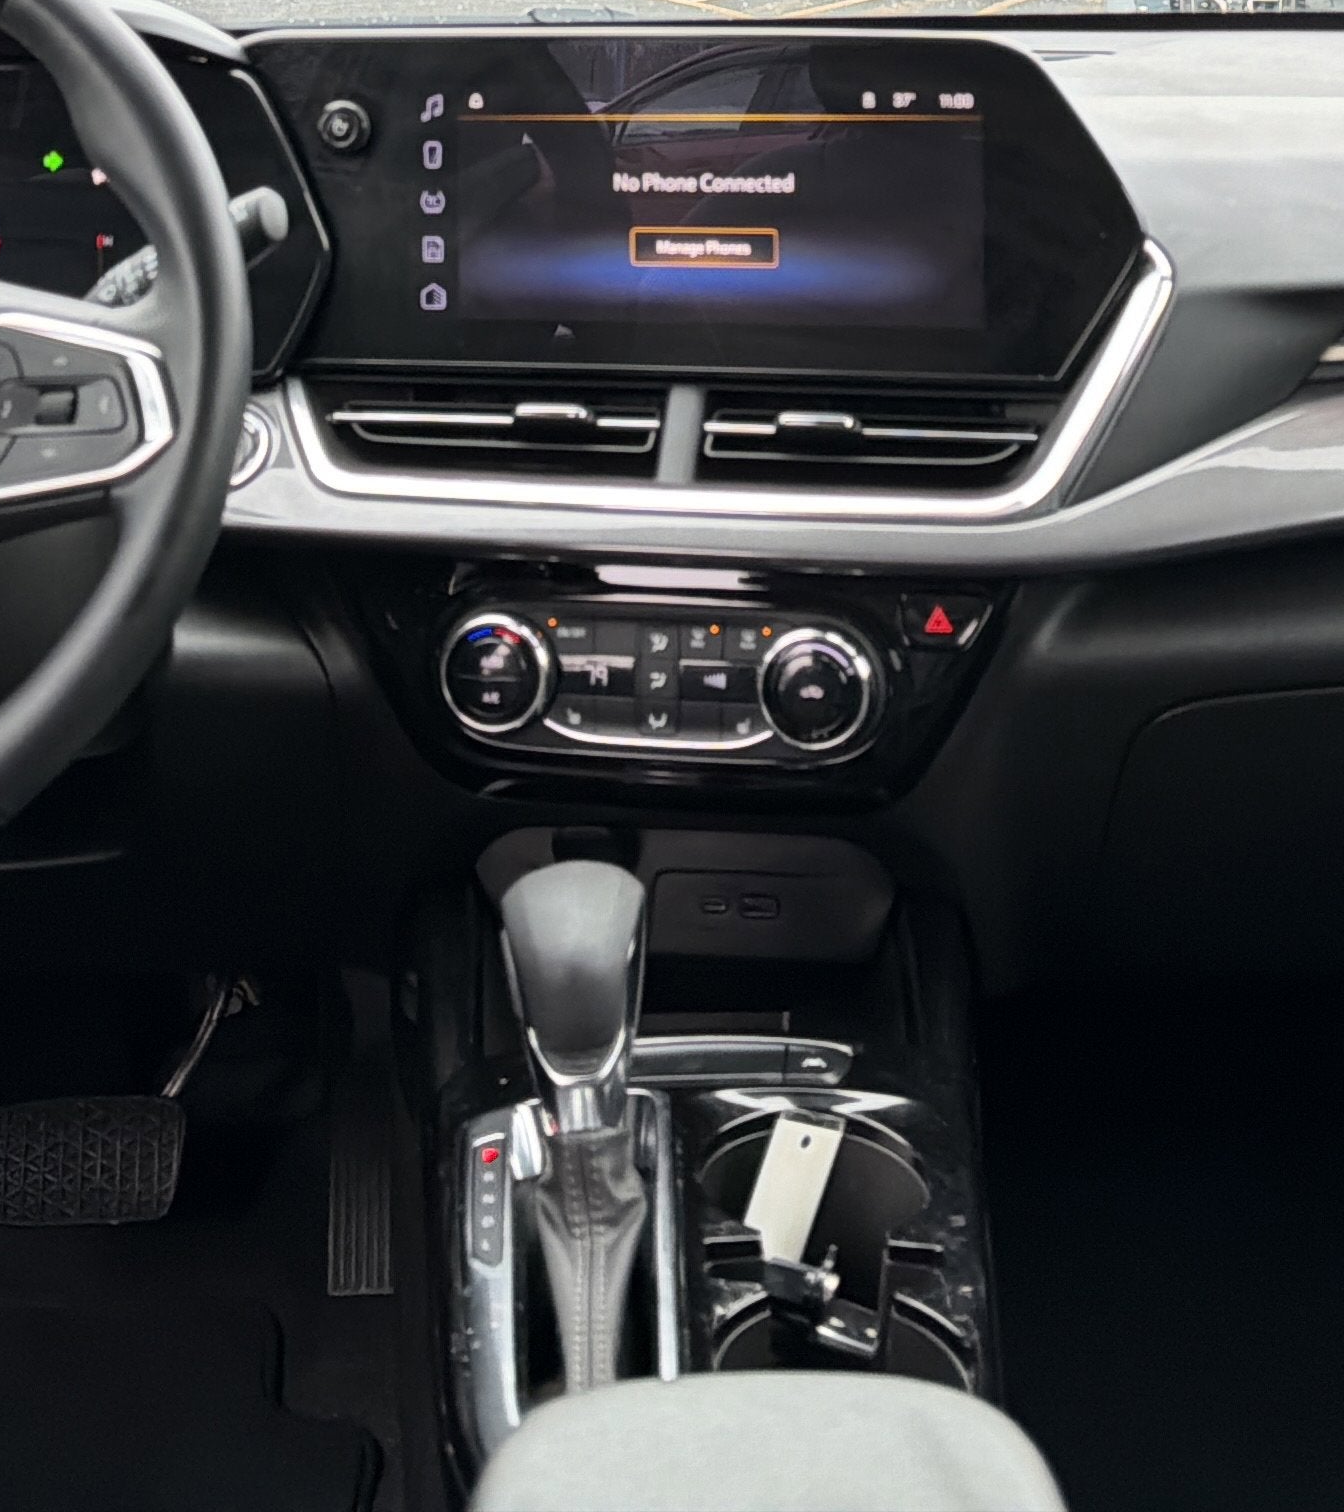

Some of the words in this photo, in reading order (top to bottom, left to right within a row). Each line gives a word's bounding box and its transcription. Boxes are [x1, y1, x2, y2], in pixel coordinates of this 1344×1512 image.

[612, 172, 641, 193] No
[641, 172, 697, 193] Phone
[699, 172, 796, 194] Connected
[705, 239, 752, 256] Phones
